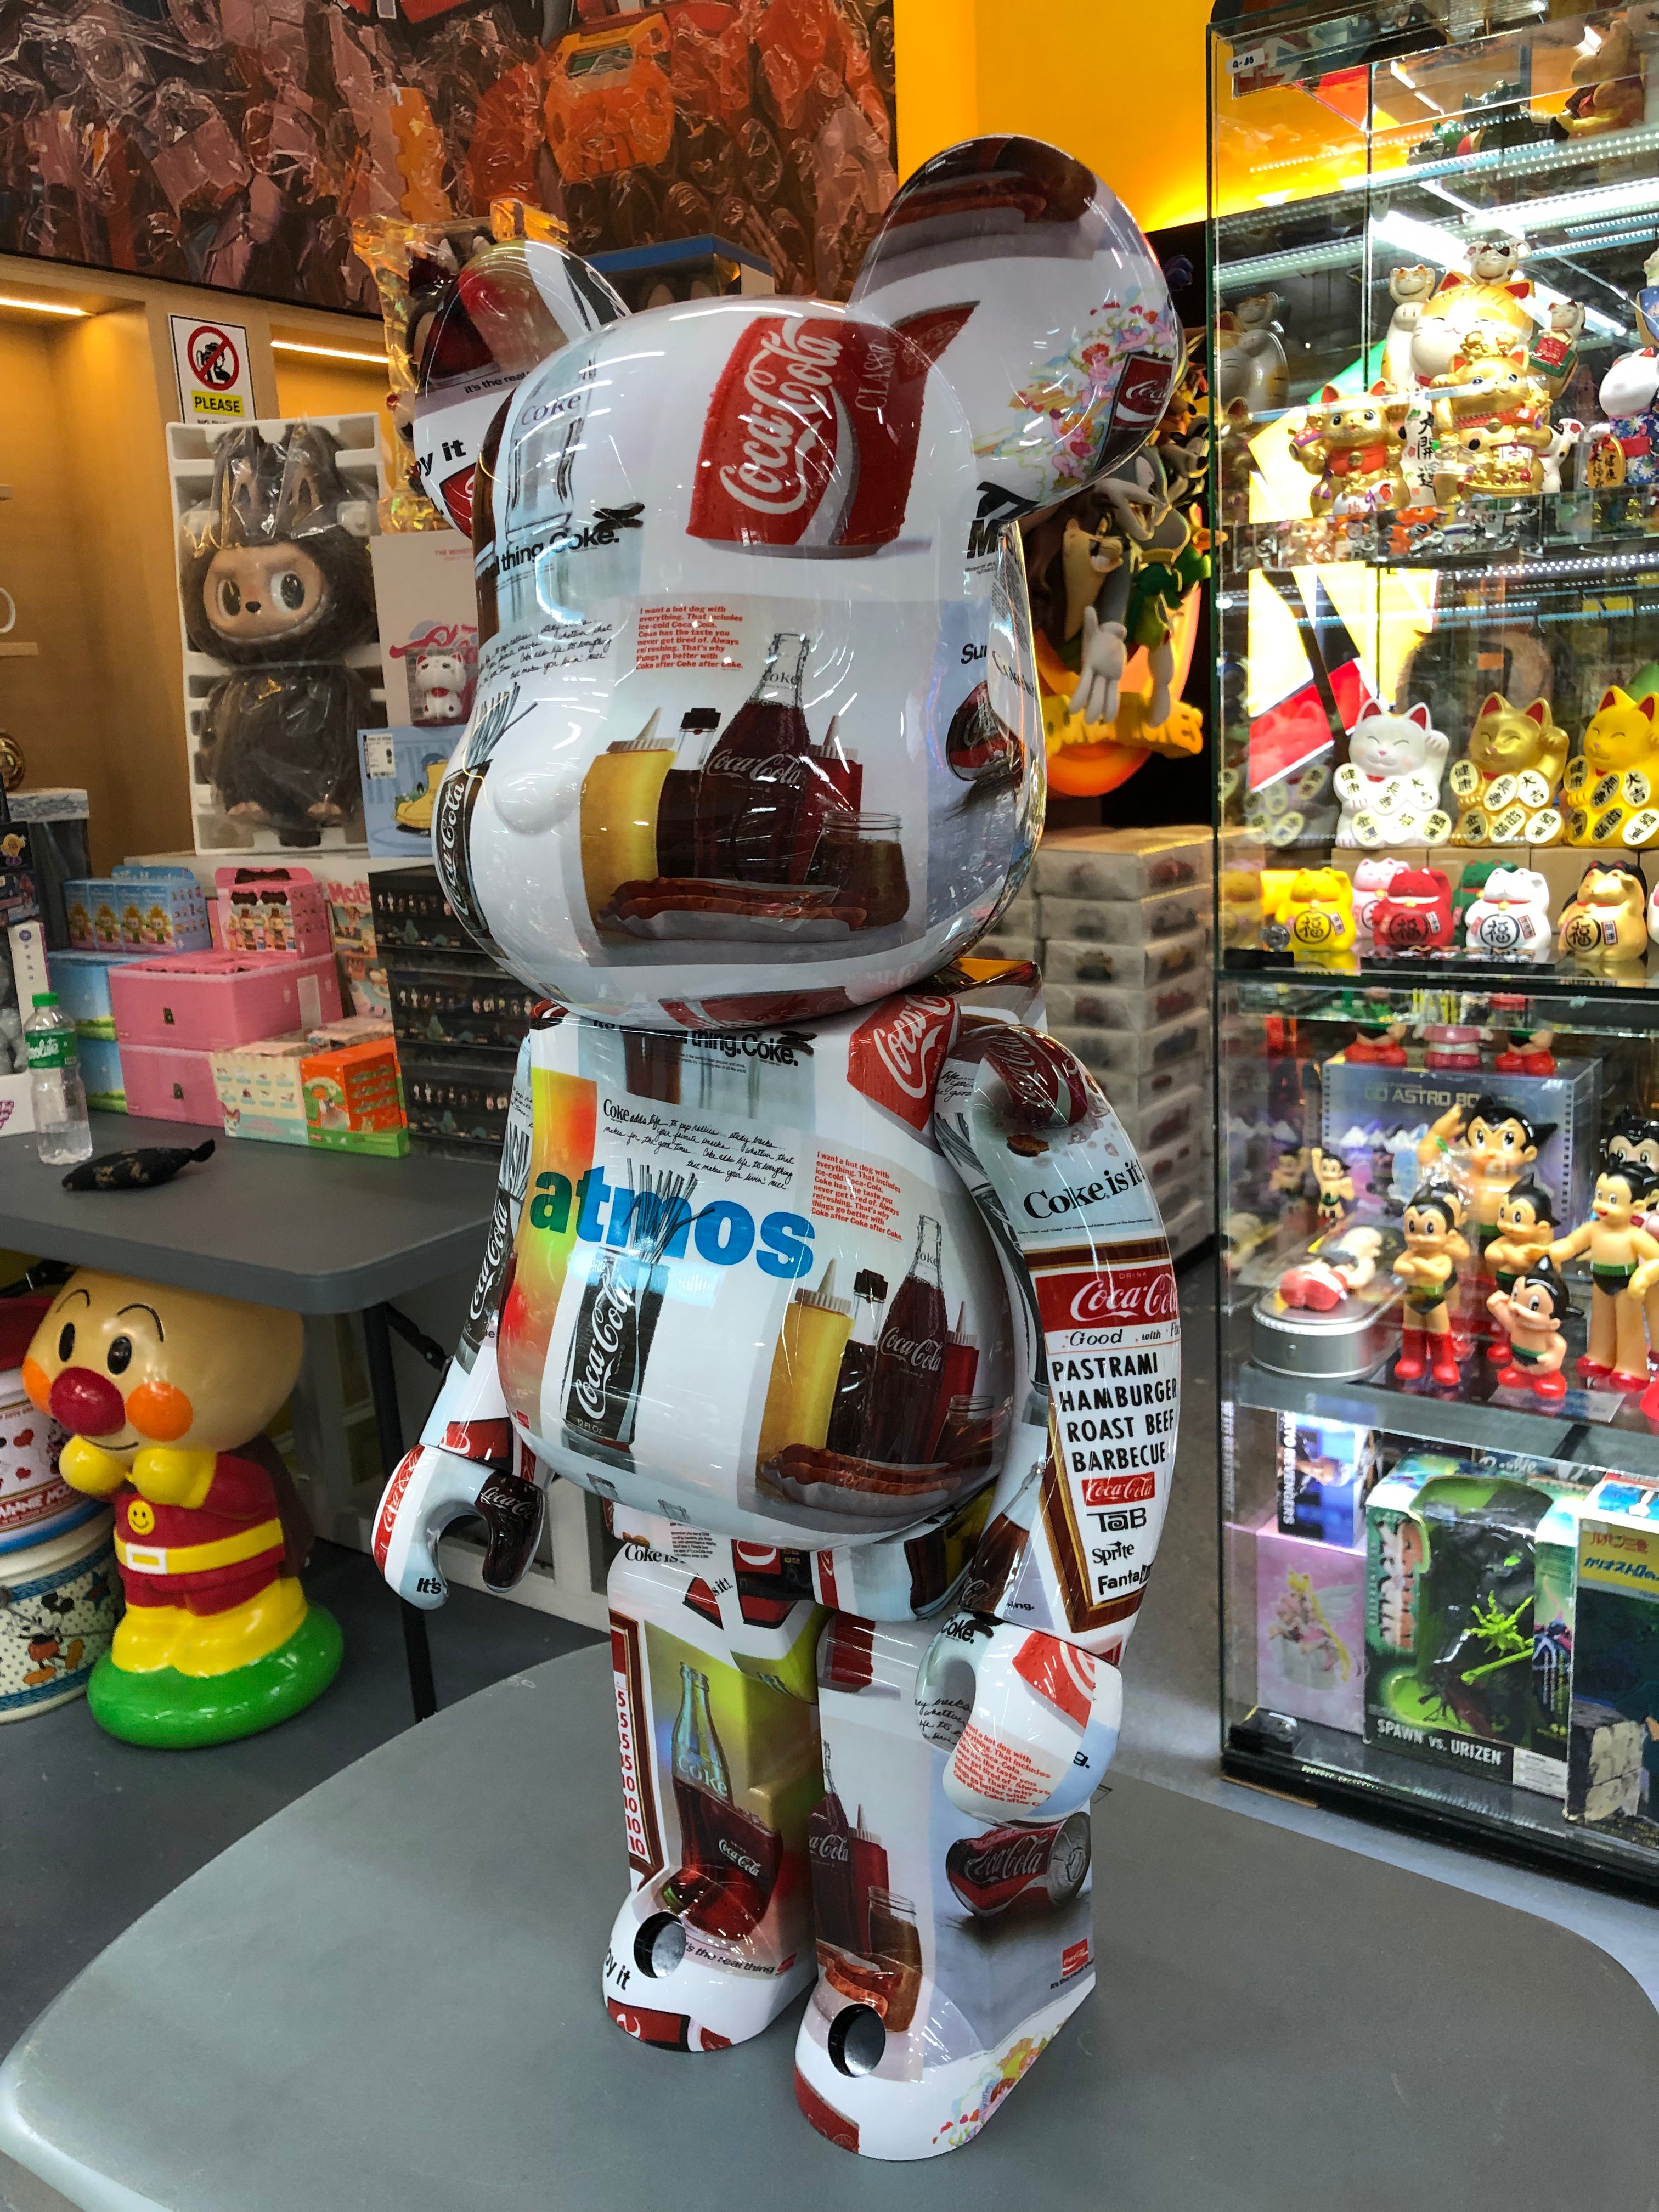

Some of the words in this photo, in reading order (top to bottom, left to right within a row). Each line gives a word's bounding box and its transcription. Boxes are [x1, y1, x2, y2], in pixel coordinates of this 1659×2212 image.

[464, 384, 479, 394] it's
[482, 377, 503, 390] the
[194, 396, 241, 413] PLEASE
[719, 324, 844, 515] Coca-Cola
[442, 439, 466, 461] it
[639, 622, 669, 630] ice-cold
[703, 749, 803, 786] Coca-Cola
[441, 782, 469, 916] Coca-Cola
[1301, 916, 1324, 938] 福
[1398, 918, 1419, 940] 福
[1485, 920, 1511, 946] 福
[1568, 922, 1592, 947] 福
[874, 996, 951, 1098] Coca-C
[603, 1098, 629, 1122] Coke
[1392, 1088, 1451, 1107] ASTRO
[641, 1136, 656, 1145] the
[702, 1148, 715, 1159] Coke
[778, 1154, 795, 1165] that
[816, 1167, 843, 1181] ice-cold
[816, 1161, 856, 1177] everything.
[859, 1171, 874, 1182] That
[877, 1177, 901, 1193] includes
[821, 1153, 838, 1163] want
[846, 1159, 857, 1169] hot
[860, 1164, 873, 1174] dog
[875, 1169, 889, 1179] with
[814, 1185, 833, 1194] never
[868, 1199, 877, 1207] of.
[879, 1202, 899, 1216] Always
[815, 1176, 832, 1186] Coke
[834, 1182, 847, 1190] has
[864, 1189, 880, 1199] taste
[882, 1196, 893, 1204] you
[1024, 1180, 1106, 1219] Coke
[1104, 1170, 1129, 1196] is
[812, 1200, 834, 1211] things
[847, 1208, 870, 1220] better
[871, 1215, 884, 1225] with
[813, 1193, 852, 1207] refreshing.
[855, 1203, 876, 1214] That's
[878, 1210, 889, 1220] why
[529, 1166, 815, 1279] atmos
[811, 1207, 829, 1217] Coke
[830, 1212, 849, 1222] after
[850, 1217, 868, 1228] Coke
[870, 1223, 885, 1233] after
[887, 1229, 903, 1241] Coke.
[470, 1196, 508, 1321] Coca-Cola
[1119, 1272, 1147, 1280] DRINK
[576, 1257, 635, 1420] Coca-Cola
[880, 1327, 943, 1372] Coca-Cola
[1069, 1329, 1124, 1347] Good
[1142, 1330, 1161, 1341] with
[1051, 1352, 1158, 1382] PASTRAMI
[1059, 1378, 1177, 1412] HAMBURGER
[1066, 1416, 1134, 1443] ROAST
[1146, 1409, 1175, 1436] BEEF
[1072, 1441, 1166, 1472] BARBECUE
[1086, 1476, 1153, 1503] Coca-Cola
[1283, 1448, 1296, 1525] REVENGERS
[625, 1544, 662, 1562] Coke
[1092, 1540, 1135, 1566] Sprite
[416, 1577, 442, 1595] It's
[1098, 1570, 1139, 1595] Fanta
[940, 1616, 975, 1644] Coke.
[1376, 1718, 1425, 1745] SPAWN
[1451, 1739, 1502, 1766] URIZEN
[678, 1756, 728, 1797] Coke
[626, 1815, 641, 1835] 10
[629, 1836, 646, 1857] 10
[719, 1839, 761, 1876] Coca-Cola
[696, 1947, 716, 1960] the
[743, 1962, 776, 1974] thing
[617, 1965, 631, 1990] it
